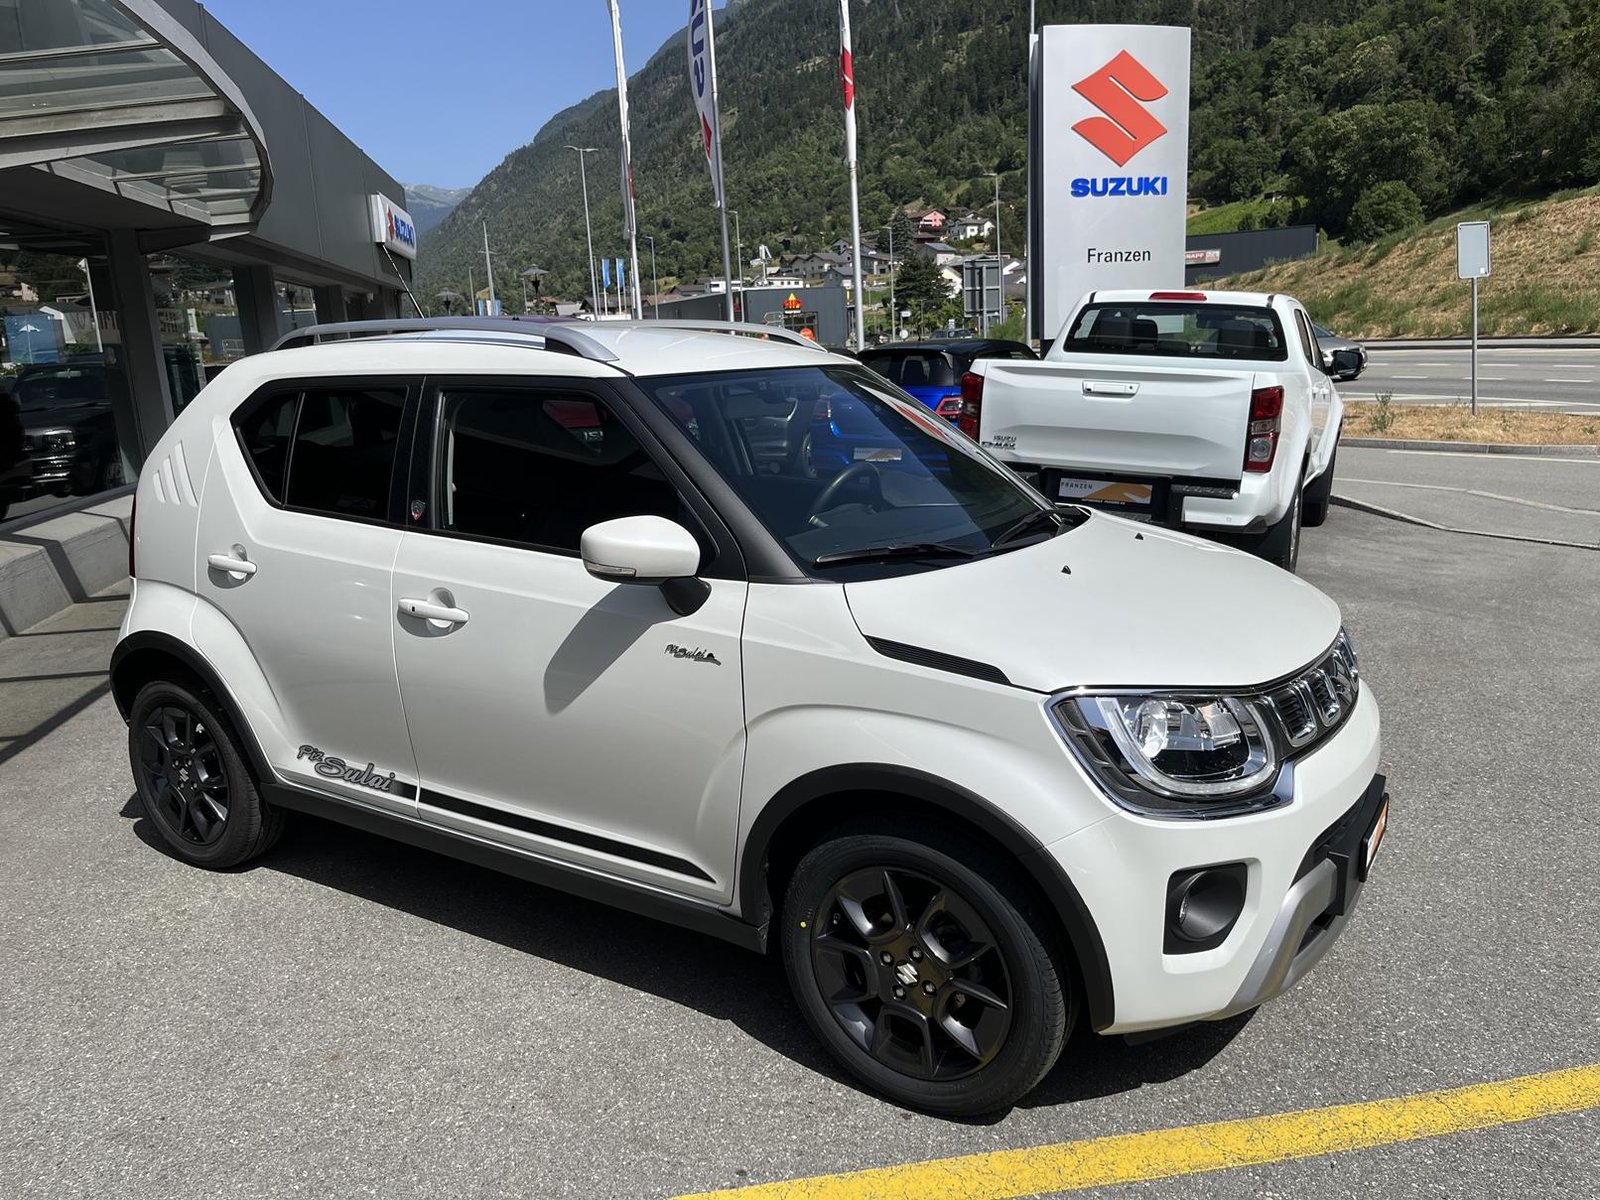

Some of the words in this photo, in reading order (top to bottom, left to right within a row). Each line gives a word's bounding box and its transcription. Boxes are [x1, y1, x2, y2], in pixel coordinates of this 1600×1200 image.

[1070, 177, 1168, 198] SUZUKI
[1087, 248, 1151, 263] Franzen
[1060, 481, 1093, 490] FRANZEN
[297, 744, 325, 761] Piz
[314, 756, 396, 792] Sulai
